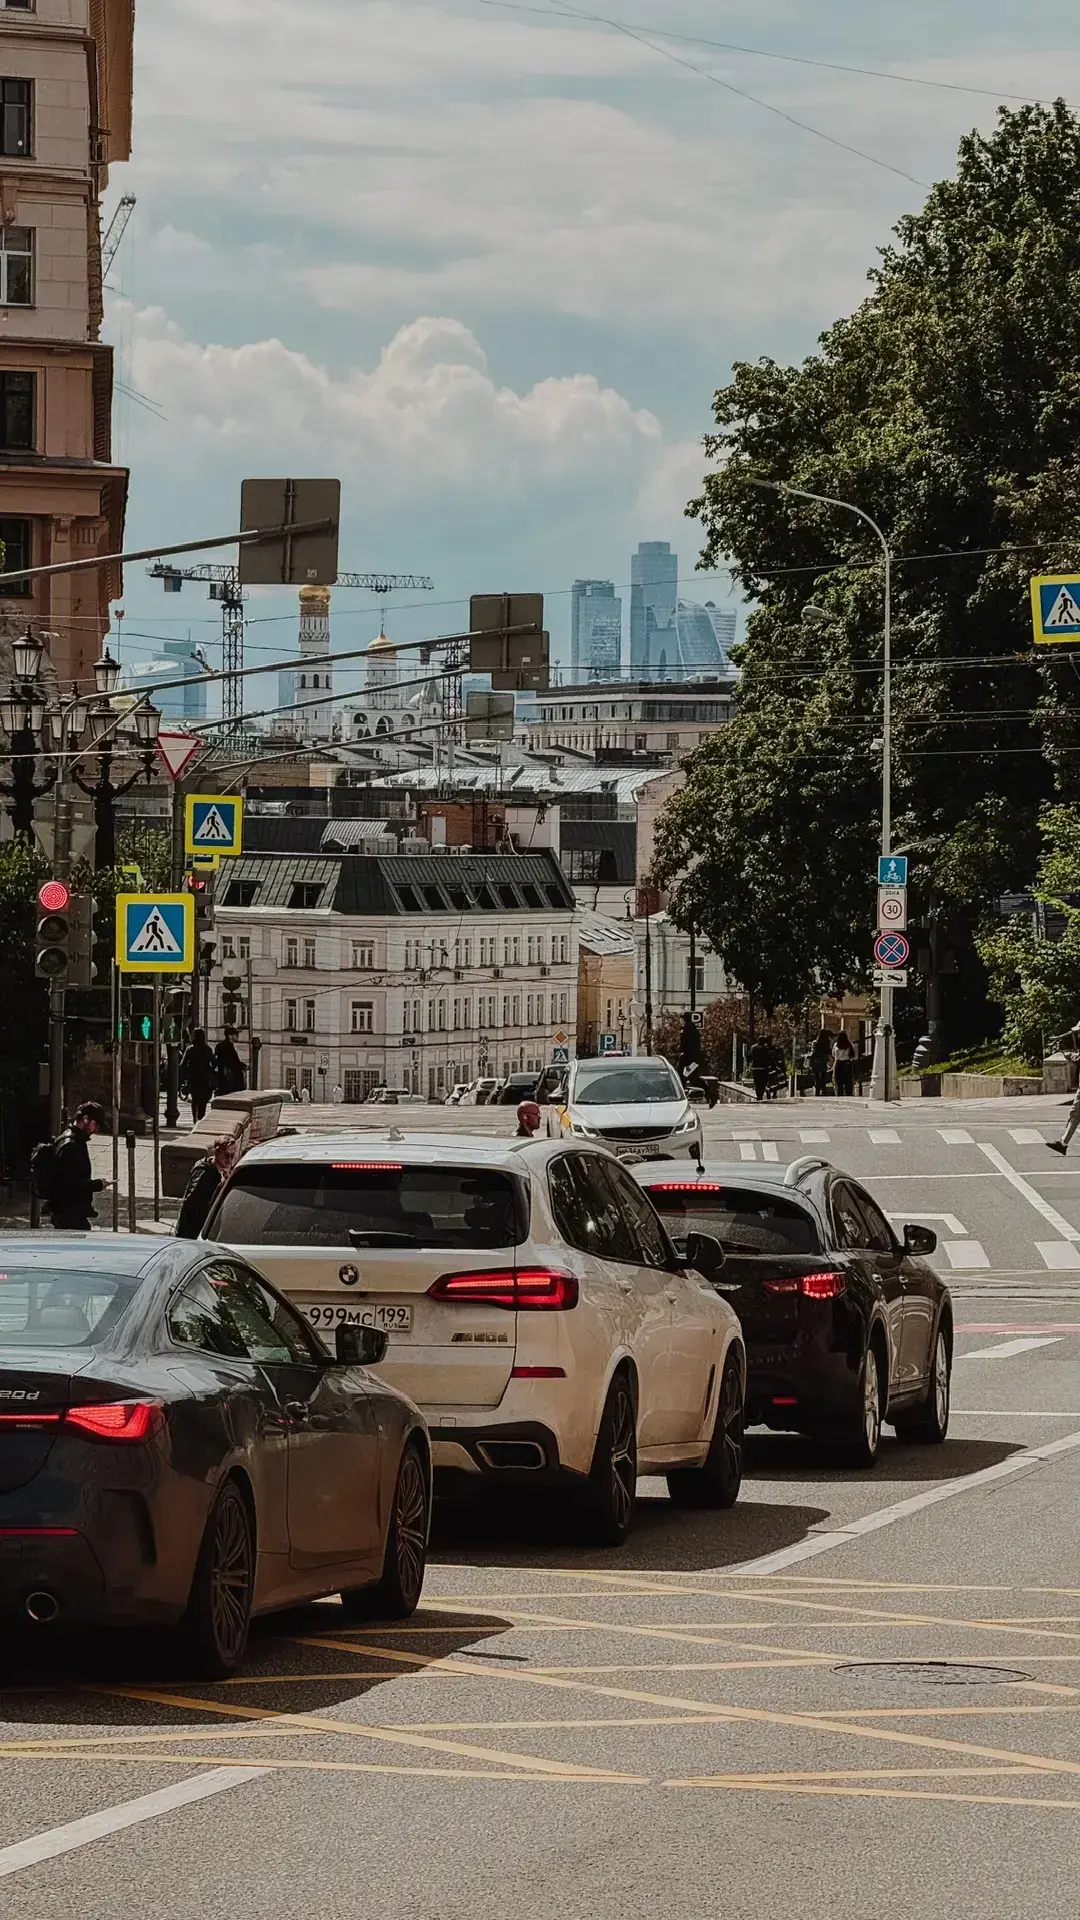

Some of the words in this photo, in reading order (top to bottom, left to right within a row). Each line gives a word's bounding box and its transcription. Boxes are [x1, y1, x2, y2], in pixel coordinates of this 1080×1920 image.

[886, 905, 898, 915] 30
[604, 1034, 614, 1049] P
[301, 1307, 373, 1326] 999MC
[377, 1307, 406, 1324] 199
